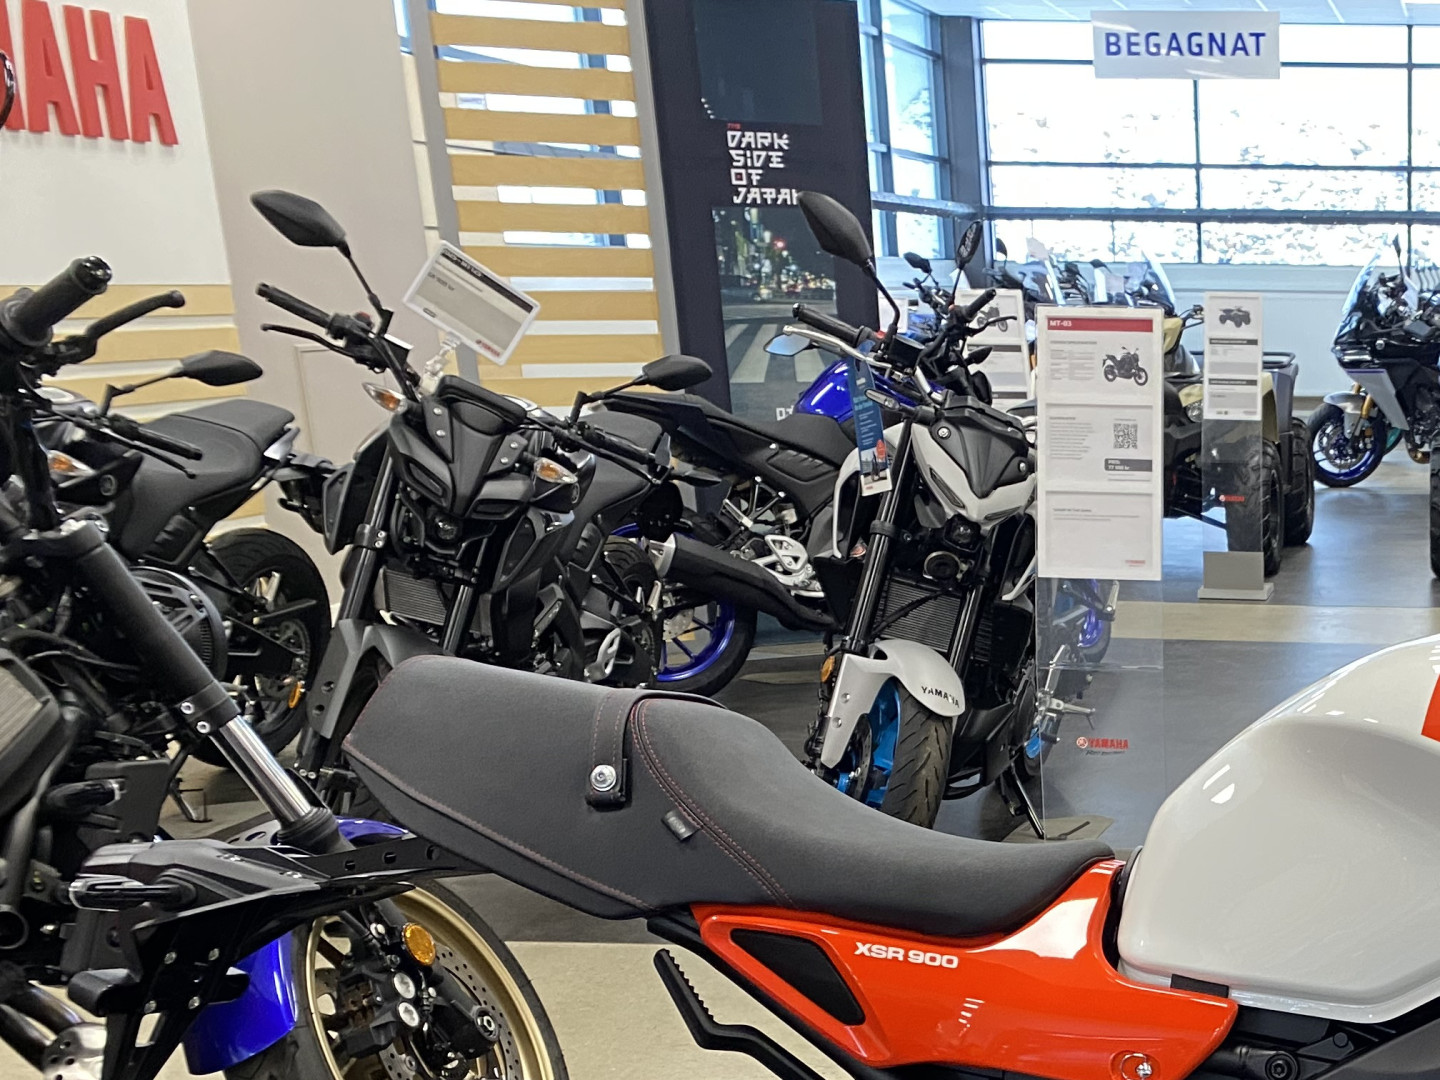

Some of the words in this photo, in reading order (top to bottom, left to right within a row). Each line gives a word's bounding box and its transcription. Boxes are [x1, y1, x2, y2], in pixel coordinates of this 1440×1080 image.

[1104, 32, 1266, 57] BEGAGNAT
[726, 131, 789, 150] DARK
[730, 168, 763, 185] OF
[921, 686, 960, 709] YAMAHA
[854, 941, 905, 961] XSR
[907, 949, 959, 969] 900
